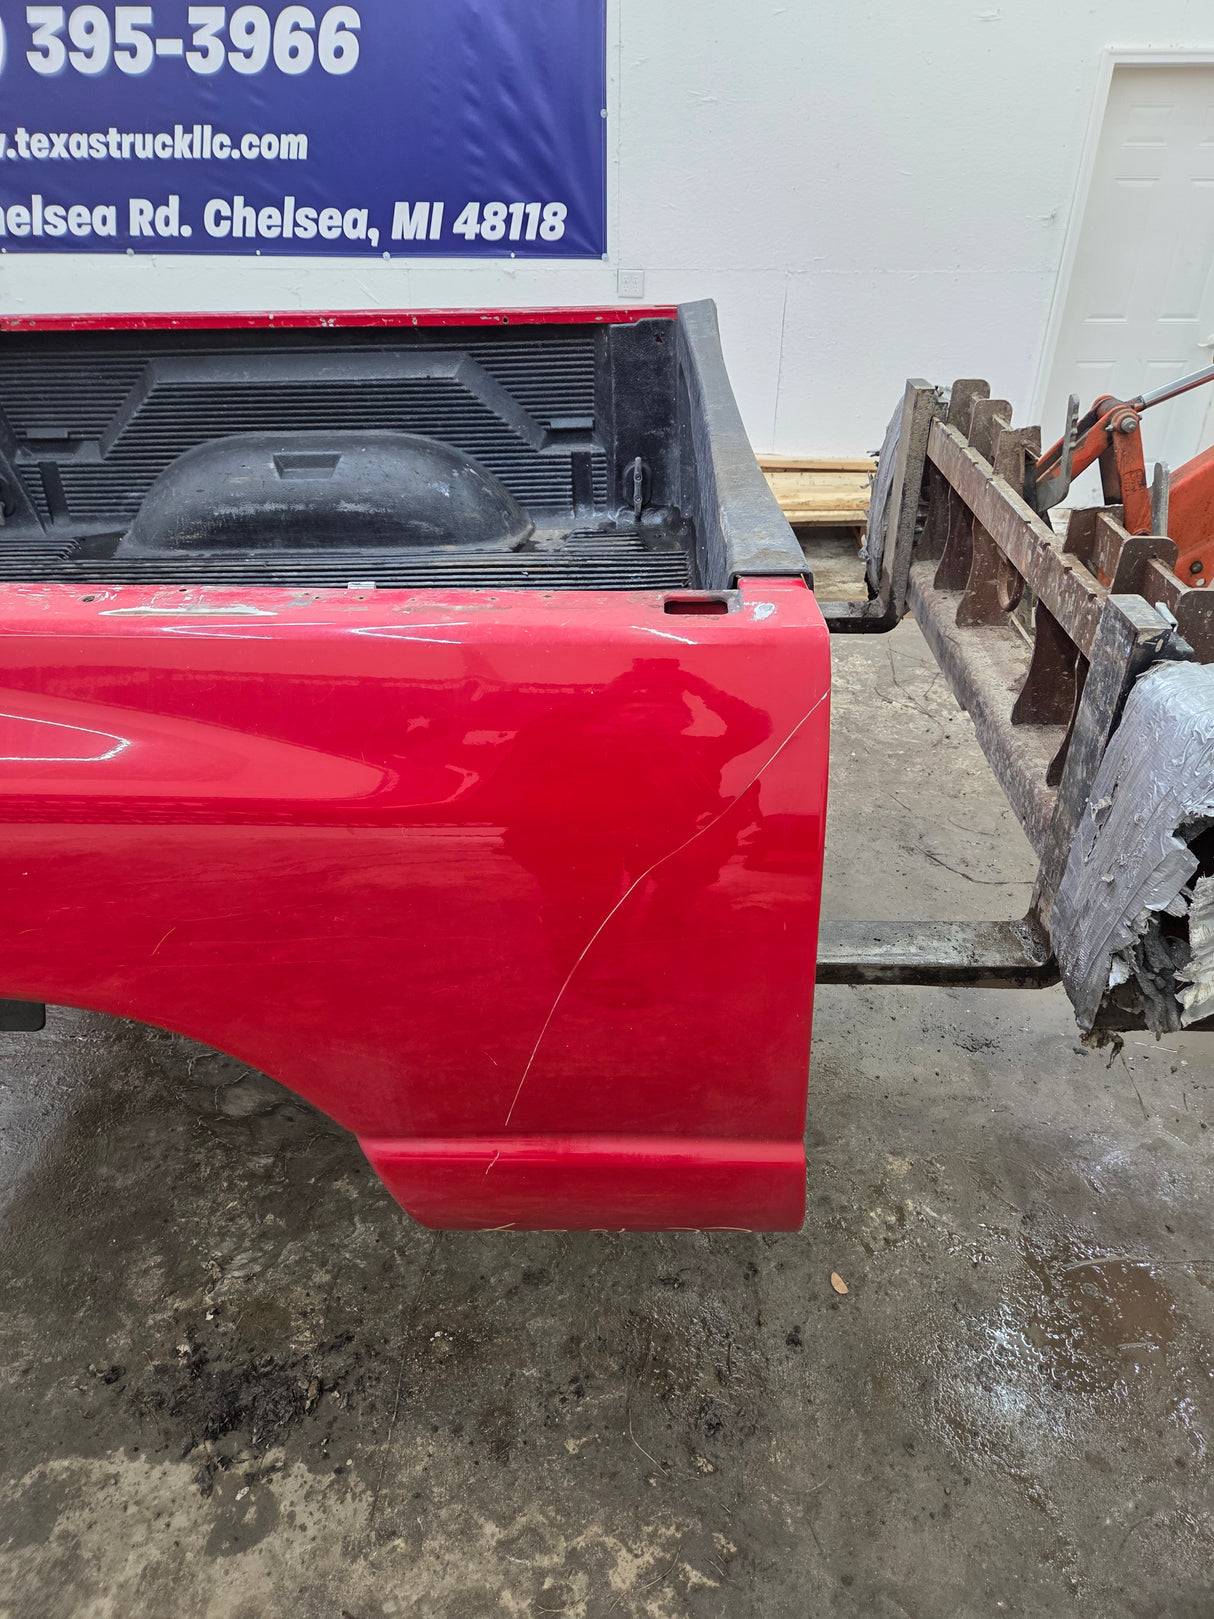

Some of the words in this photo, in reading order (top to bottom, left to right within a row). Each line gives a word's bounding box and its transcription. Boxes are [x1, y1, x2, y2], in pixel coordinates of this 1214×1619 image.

[26, 5, 361, 75] 395-3966
[0, 125, 309, 160] .texastruckllc.com
[0, 194, 117, 238] elsea
[129, 195, 193, 238] Rd.
[204, 196, 379, 247] Chelsea,
[391, 201, 444, 241] MI
[453, 202, 568, 241] 48118
